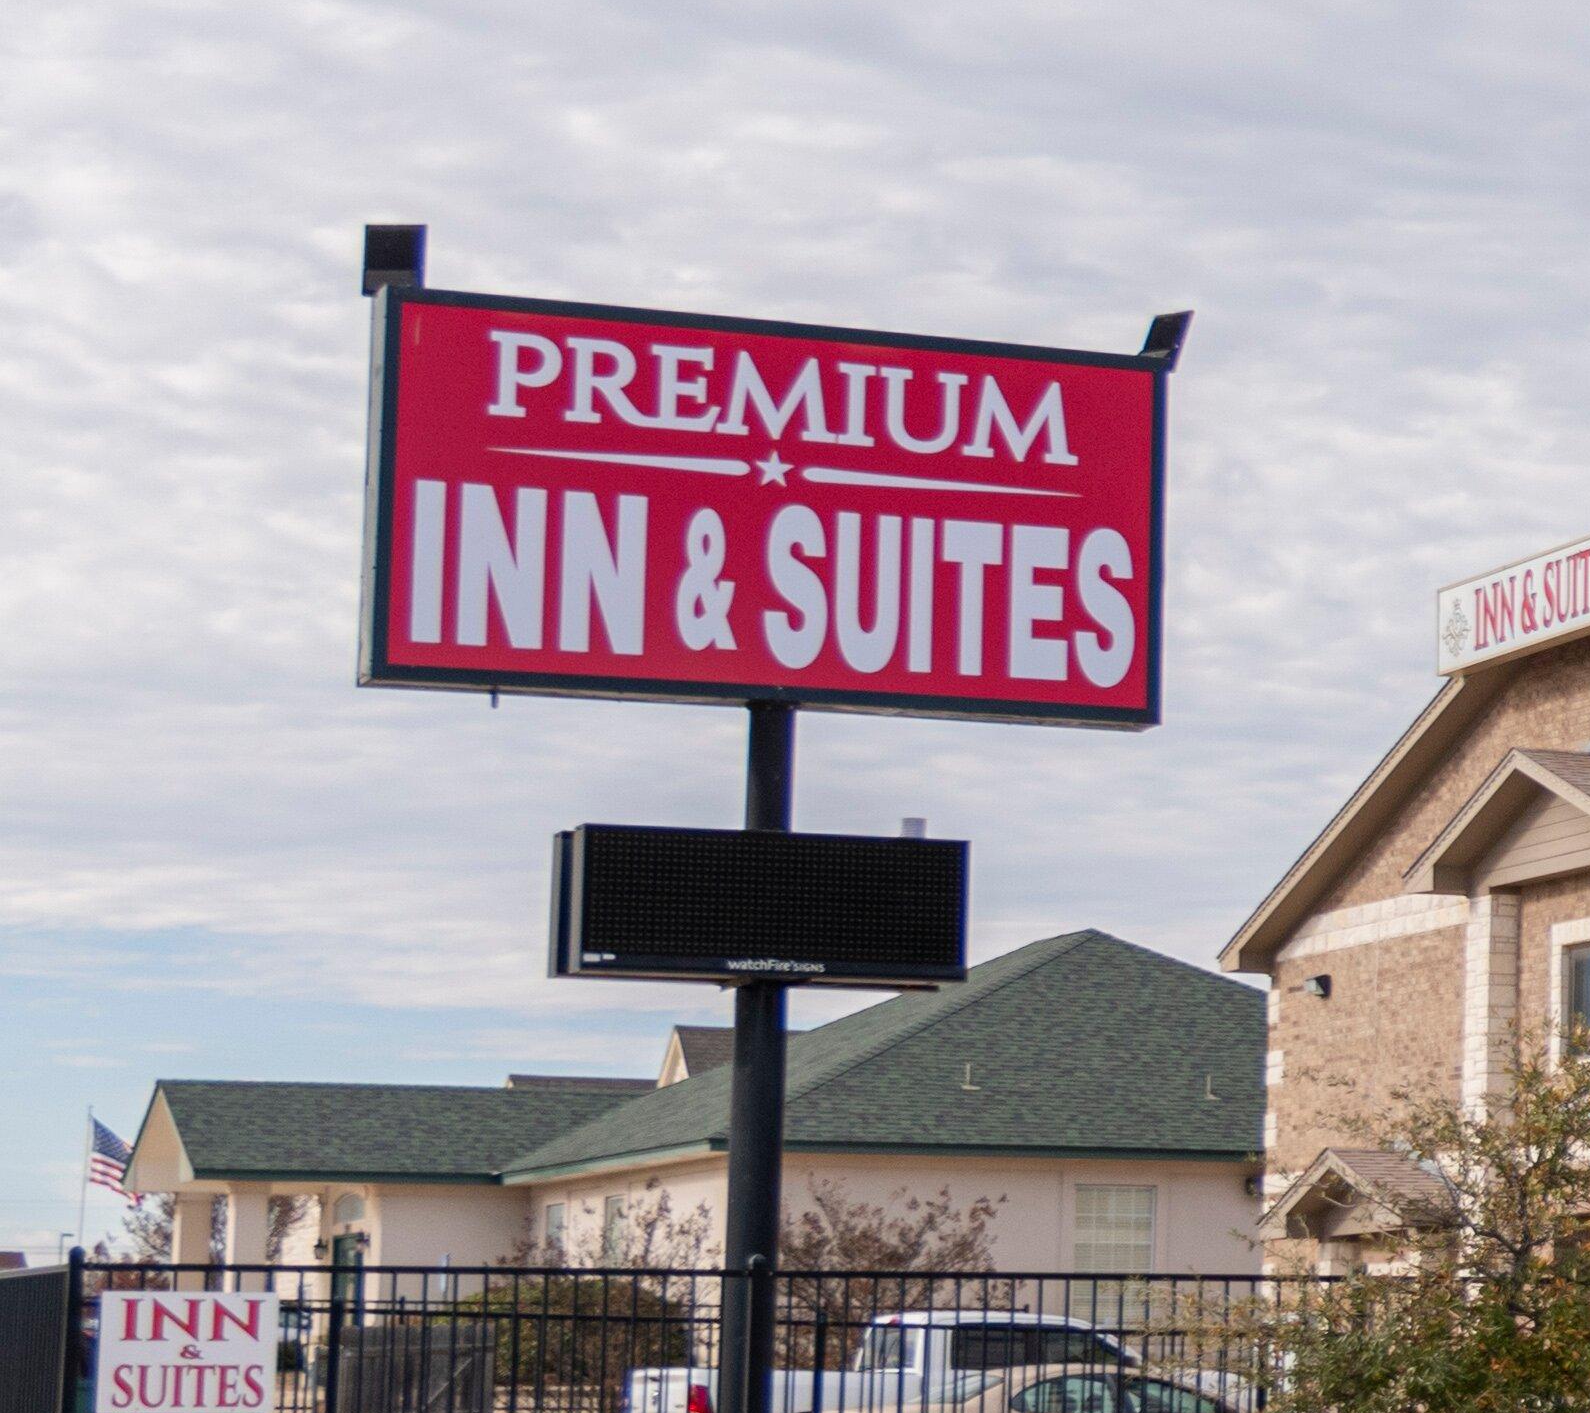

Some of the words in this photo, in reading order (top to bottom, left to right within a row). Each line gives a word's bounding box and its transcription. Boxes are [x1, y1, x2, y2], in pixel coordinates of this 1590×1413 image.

[487, 330, 1079, 466] PREMIUM
[410, 479, 648, 656] INN
[675, 508, 738, 651] &
[763, 504, 1135, 688] SUITES
[1473, 575, 1518, 651] INN
[1521, 568, 1539, 635] &
[120, 1297, 266, 1343] INN
[179, 1344, 203, 1360] &
[111, 1363, 265, 1409] SUITES
